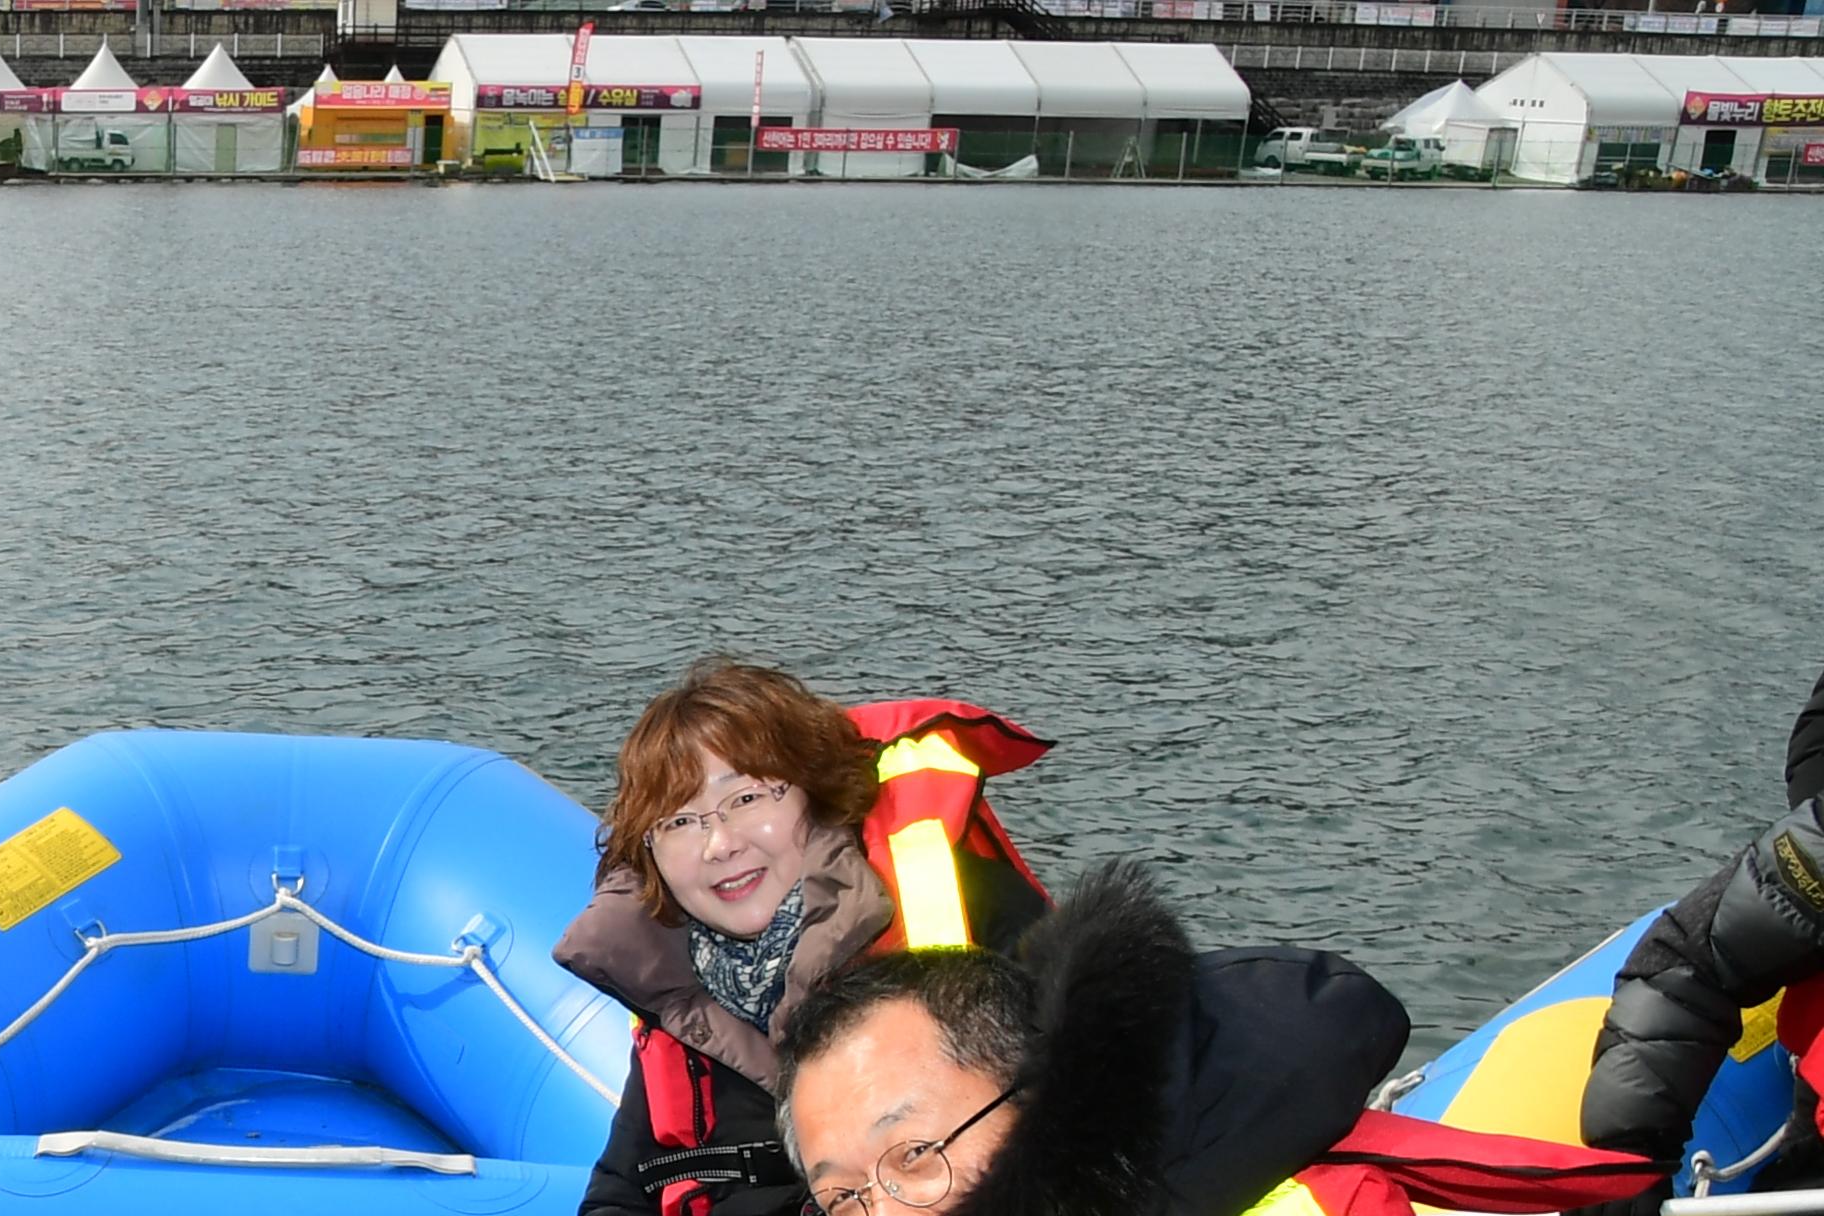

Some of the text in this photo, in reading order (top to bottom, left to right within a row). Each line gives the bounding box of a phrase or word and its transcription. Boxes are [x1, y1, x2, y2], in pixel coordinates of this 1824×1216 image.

[573, 66, 582, 79] 3
[215, 92, 239, 108] 낚시
[242, 92, 279, 107] 가이드
[598, 88, 639, 107] 수유실
[1706, 98, 1824, 123] 물빛누리 향토주전
[860, 131, 884, 150] 잡으실
[885, 132, 896, 149] 수
